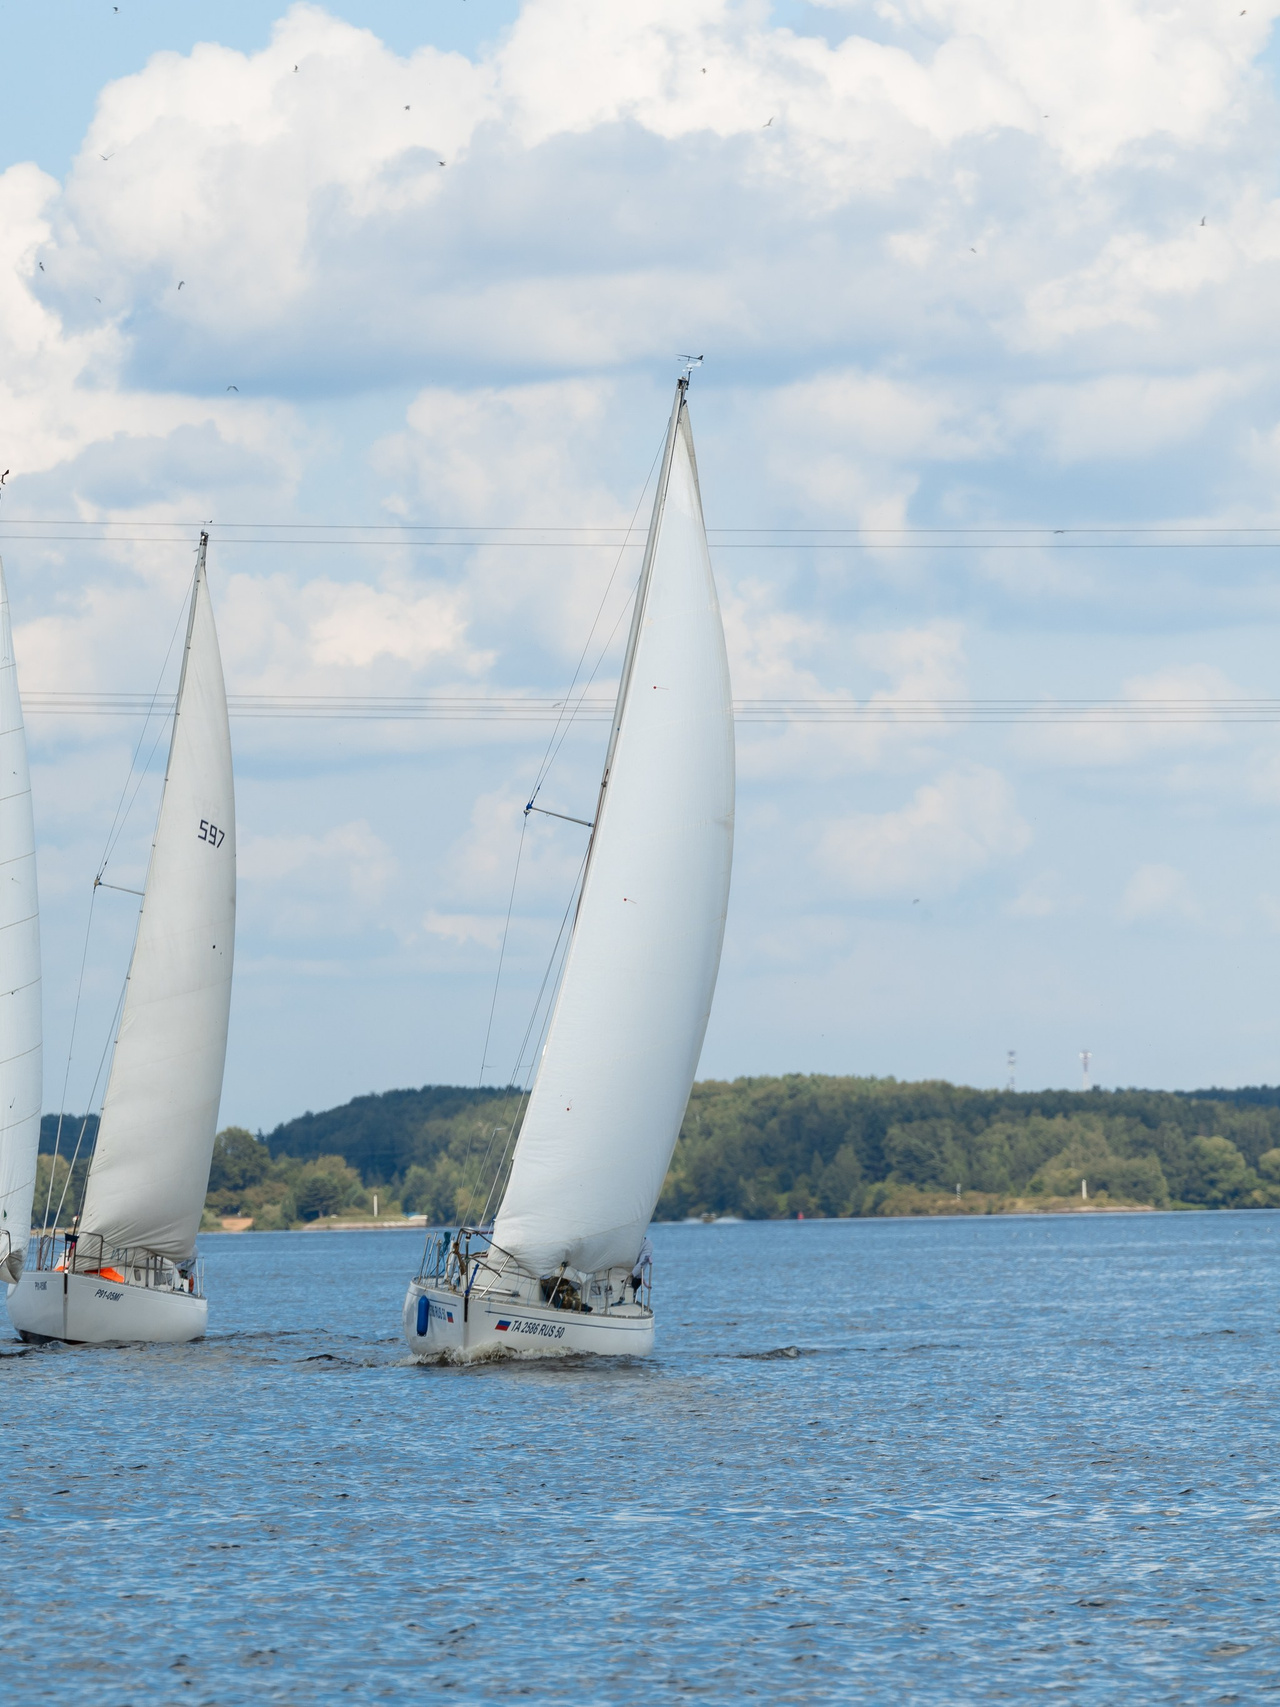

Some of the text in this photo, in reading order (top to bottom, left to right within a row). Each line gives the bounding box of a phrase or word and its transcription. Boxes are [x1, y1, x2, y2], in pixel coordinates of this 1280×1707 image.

[197, 819, 225, 849] 597
[510, 1320, 566, 1339] TA 2586 RUS 50
